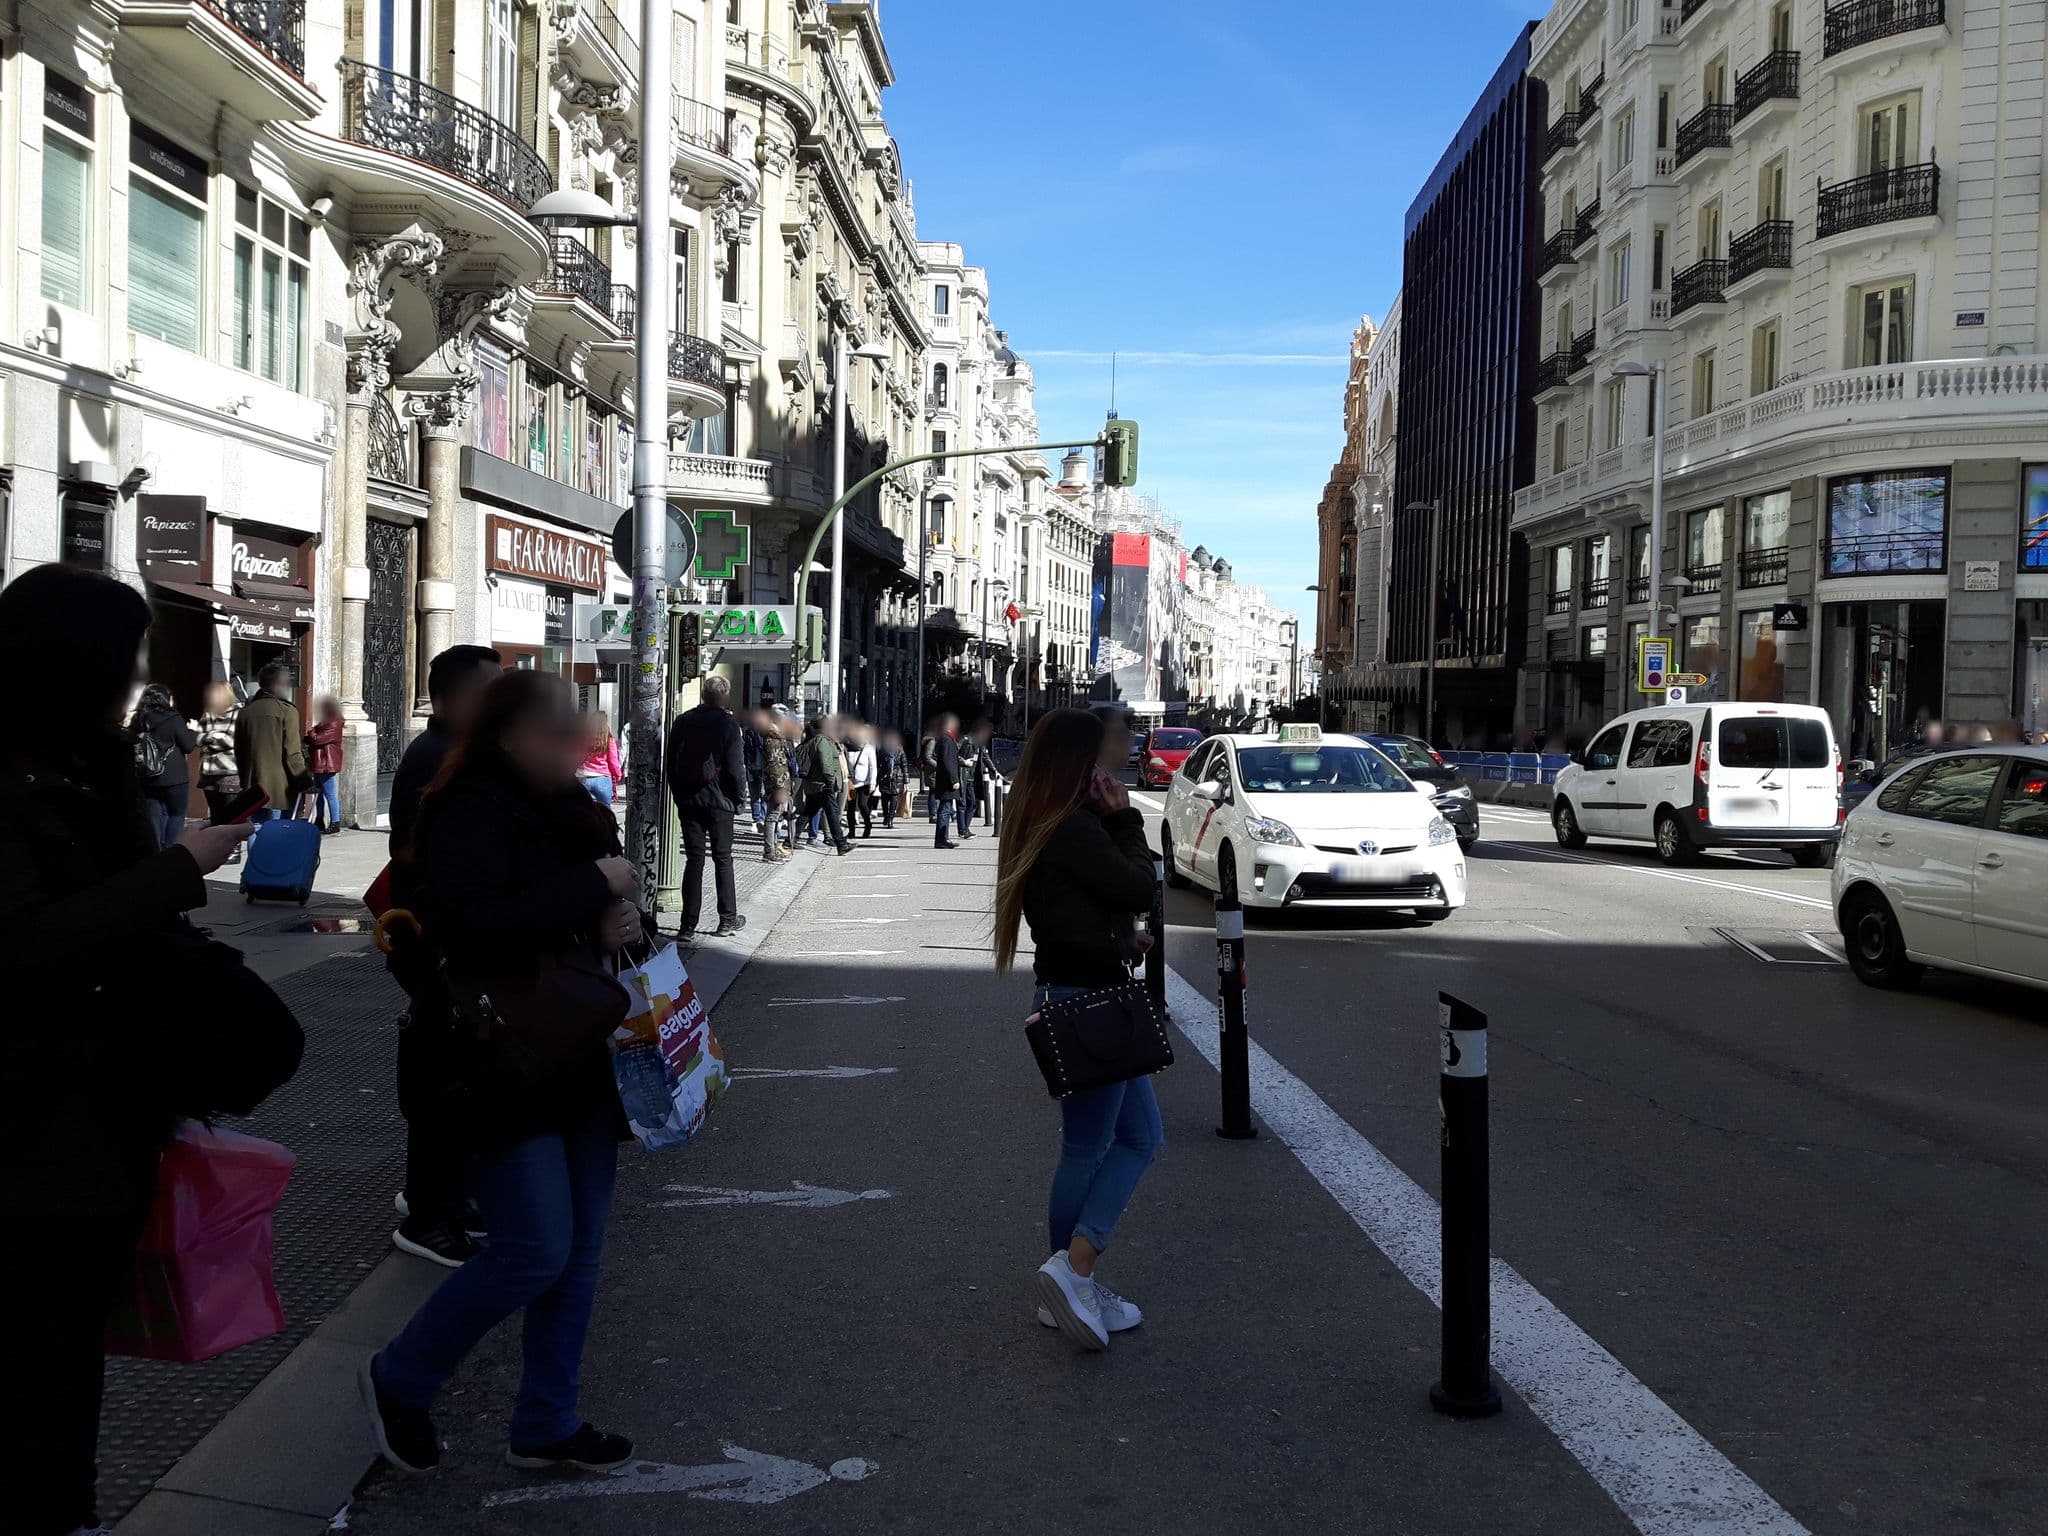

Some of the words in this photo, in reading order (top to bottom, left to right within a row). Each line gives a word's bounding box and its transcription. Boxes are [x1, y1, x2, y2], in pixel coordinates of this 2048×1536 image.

[143, 515, 190, 532] Papizza
[232, 542, 285, 580] Papizza
[513, 527, 601, 586] FARMACIA
[1290, 725, 1310, 739] TAXI
